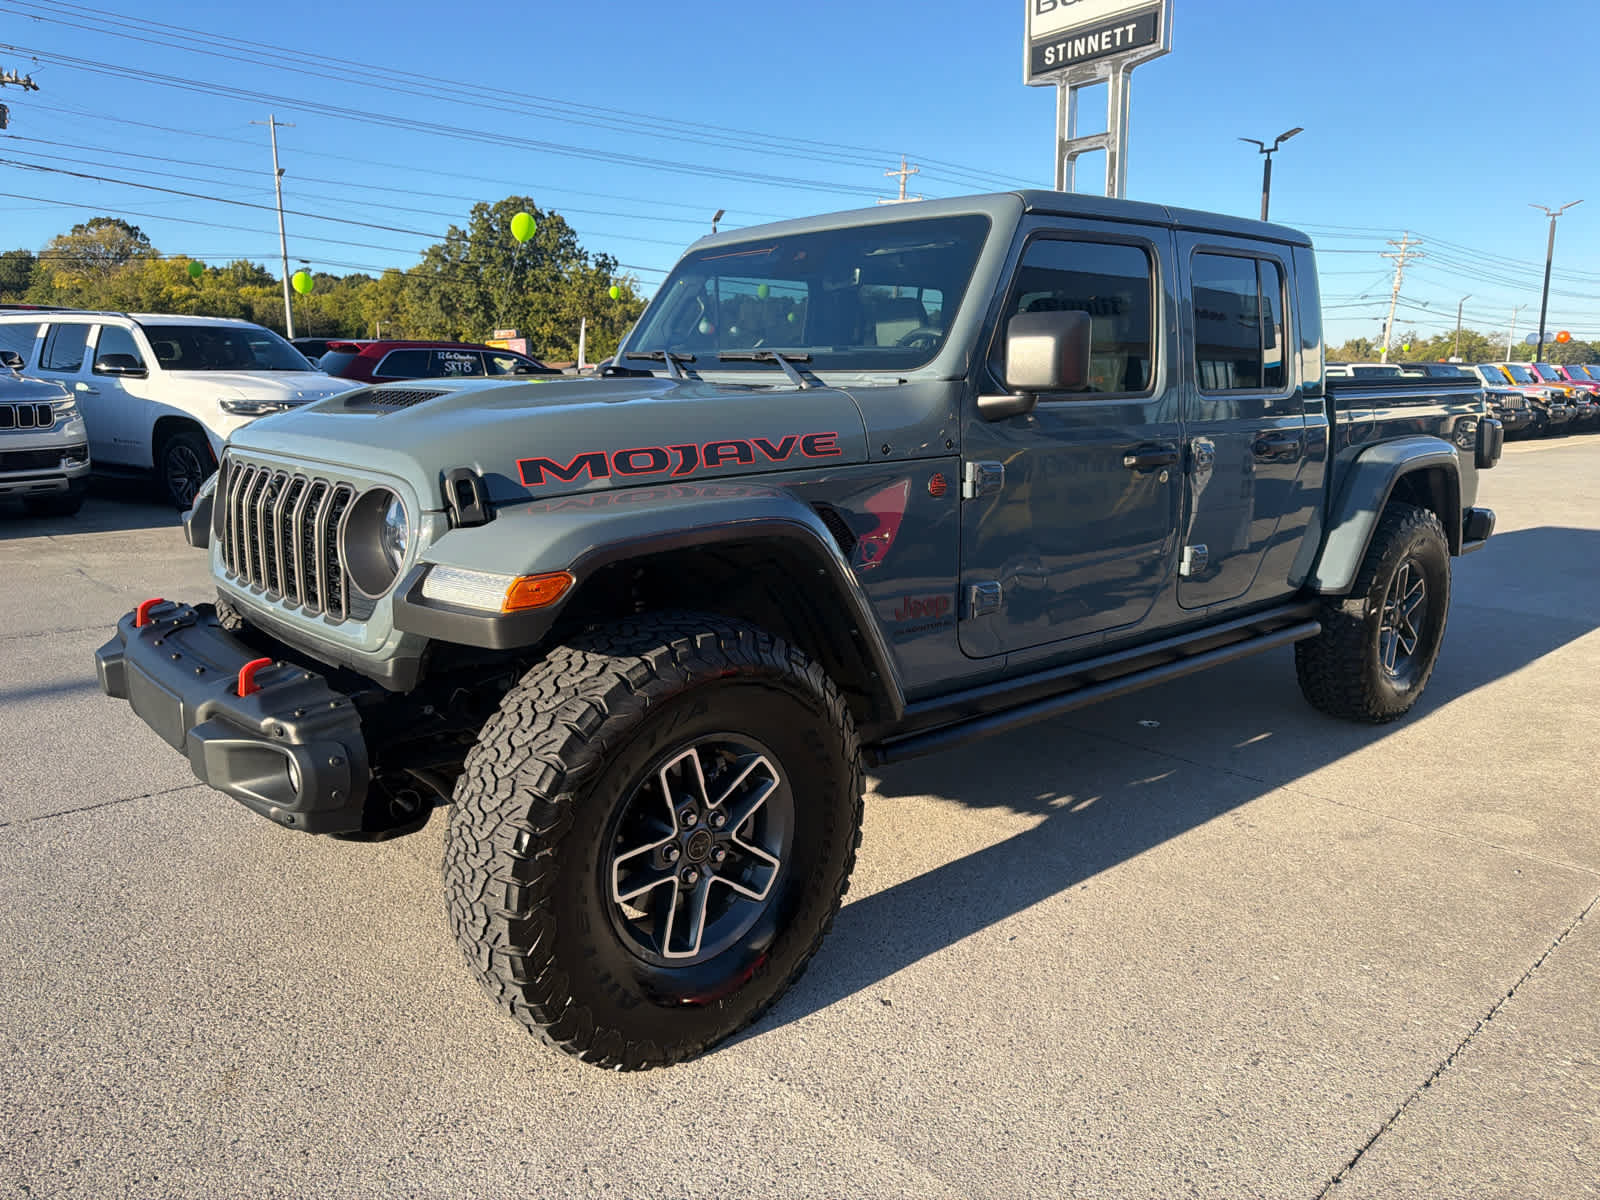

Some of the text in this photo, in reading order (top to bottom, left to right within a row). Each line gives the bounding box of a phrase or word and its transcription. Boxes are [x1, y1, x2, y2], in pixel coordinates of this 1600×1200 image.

[1044, 23, 1137, 65] STINNETT
[516, 431, 842, 487] MOJAVE
[895, 594, 950, 622] Jeep
